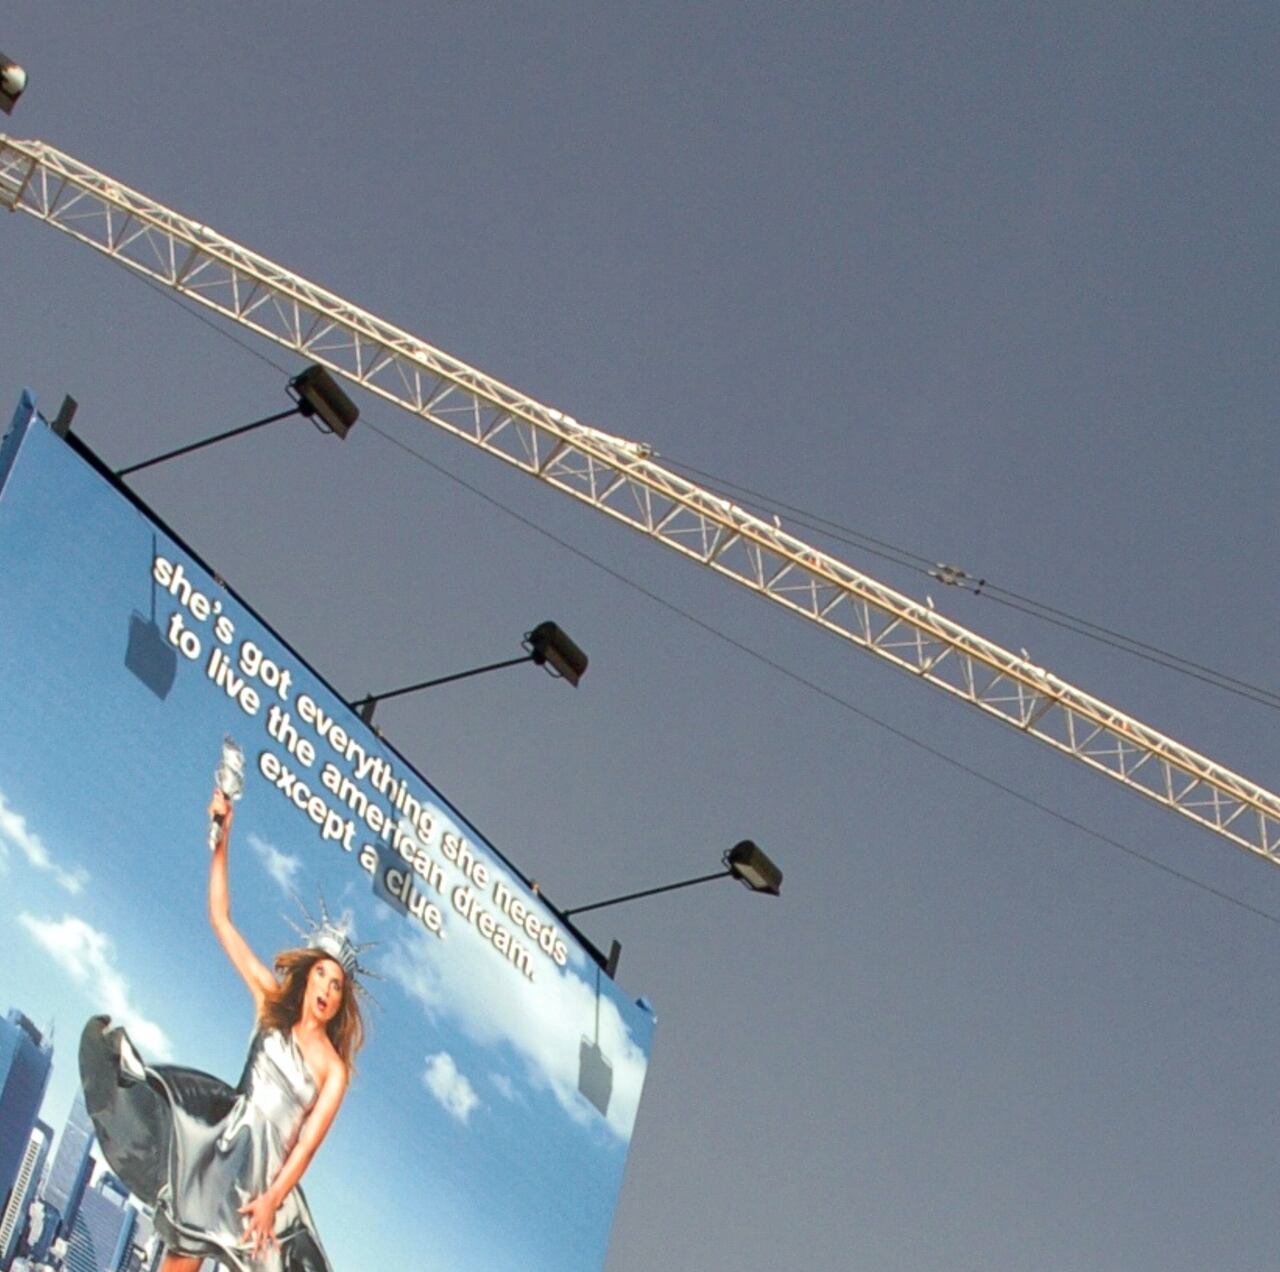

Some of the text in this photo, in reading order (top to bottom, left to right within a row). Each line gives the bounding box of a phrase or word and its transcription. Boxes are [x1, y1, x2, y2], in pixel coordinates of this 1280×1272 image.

[153, 556, 569, 967] she's got everything she needs
[169, 612, 536, 983] to live the american dream.
[259, 752, 447, 939] except a clue.
